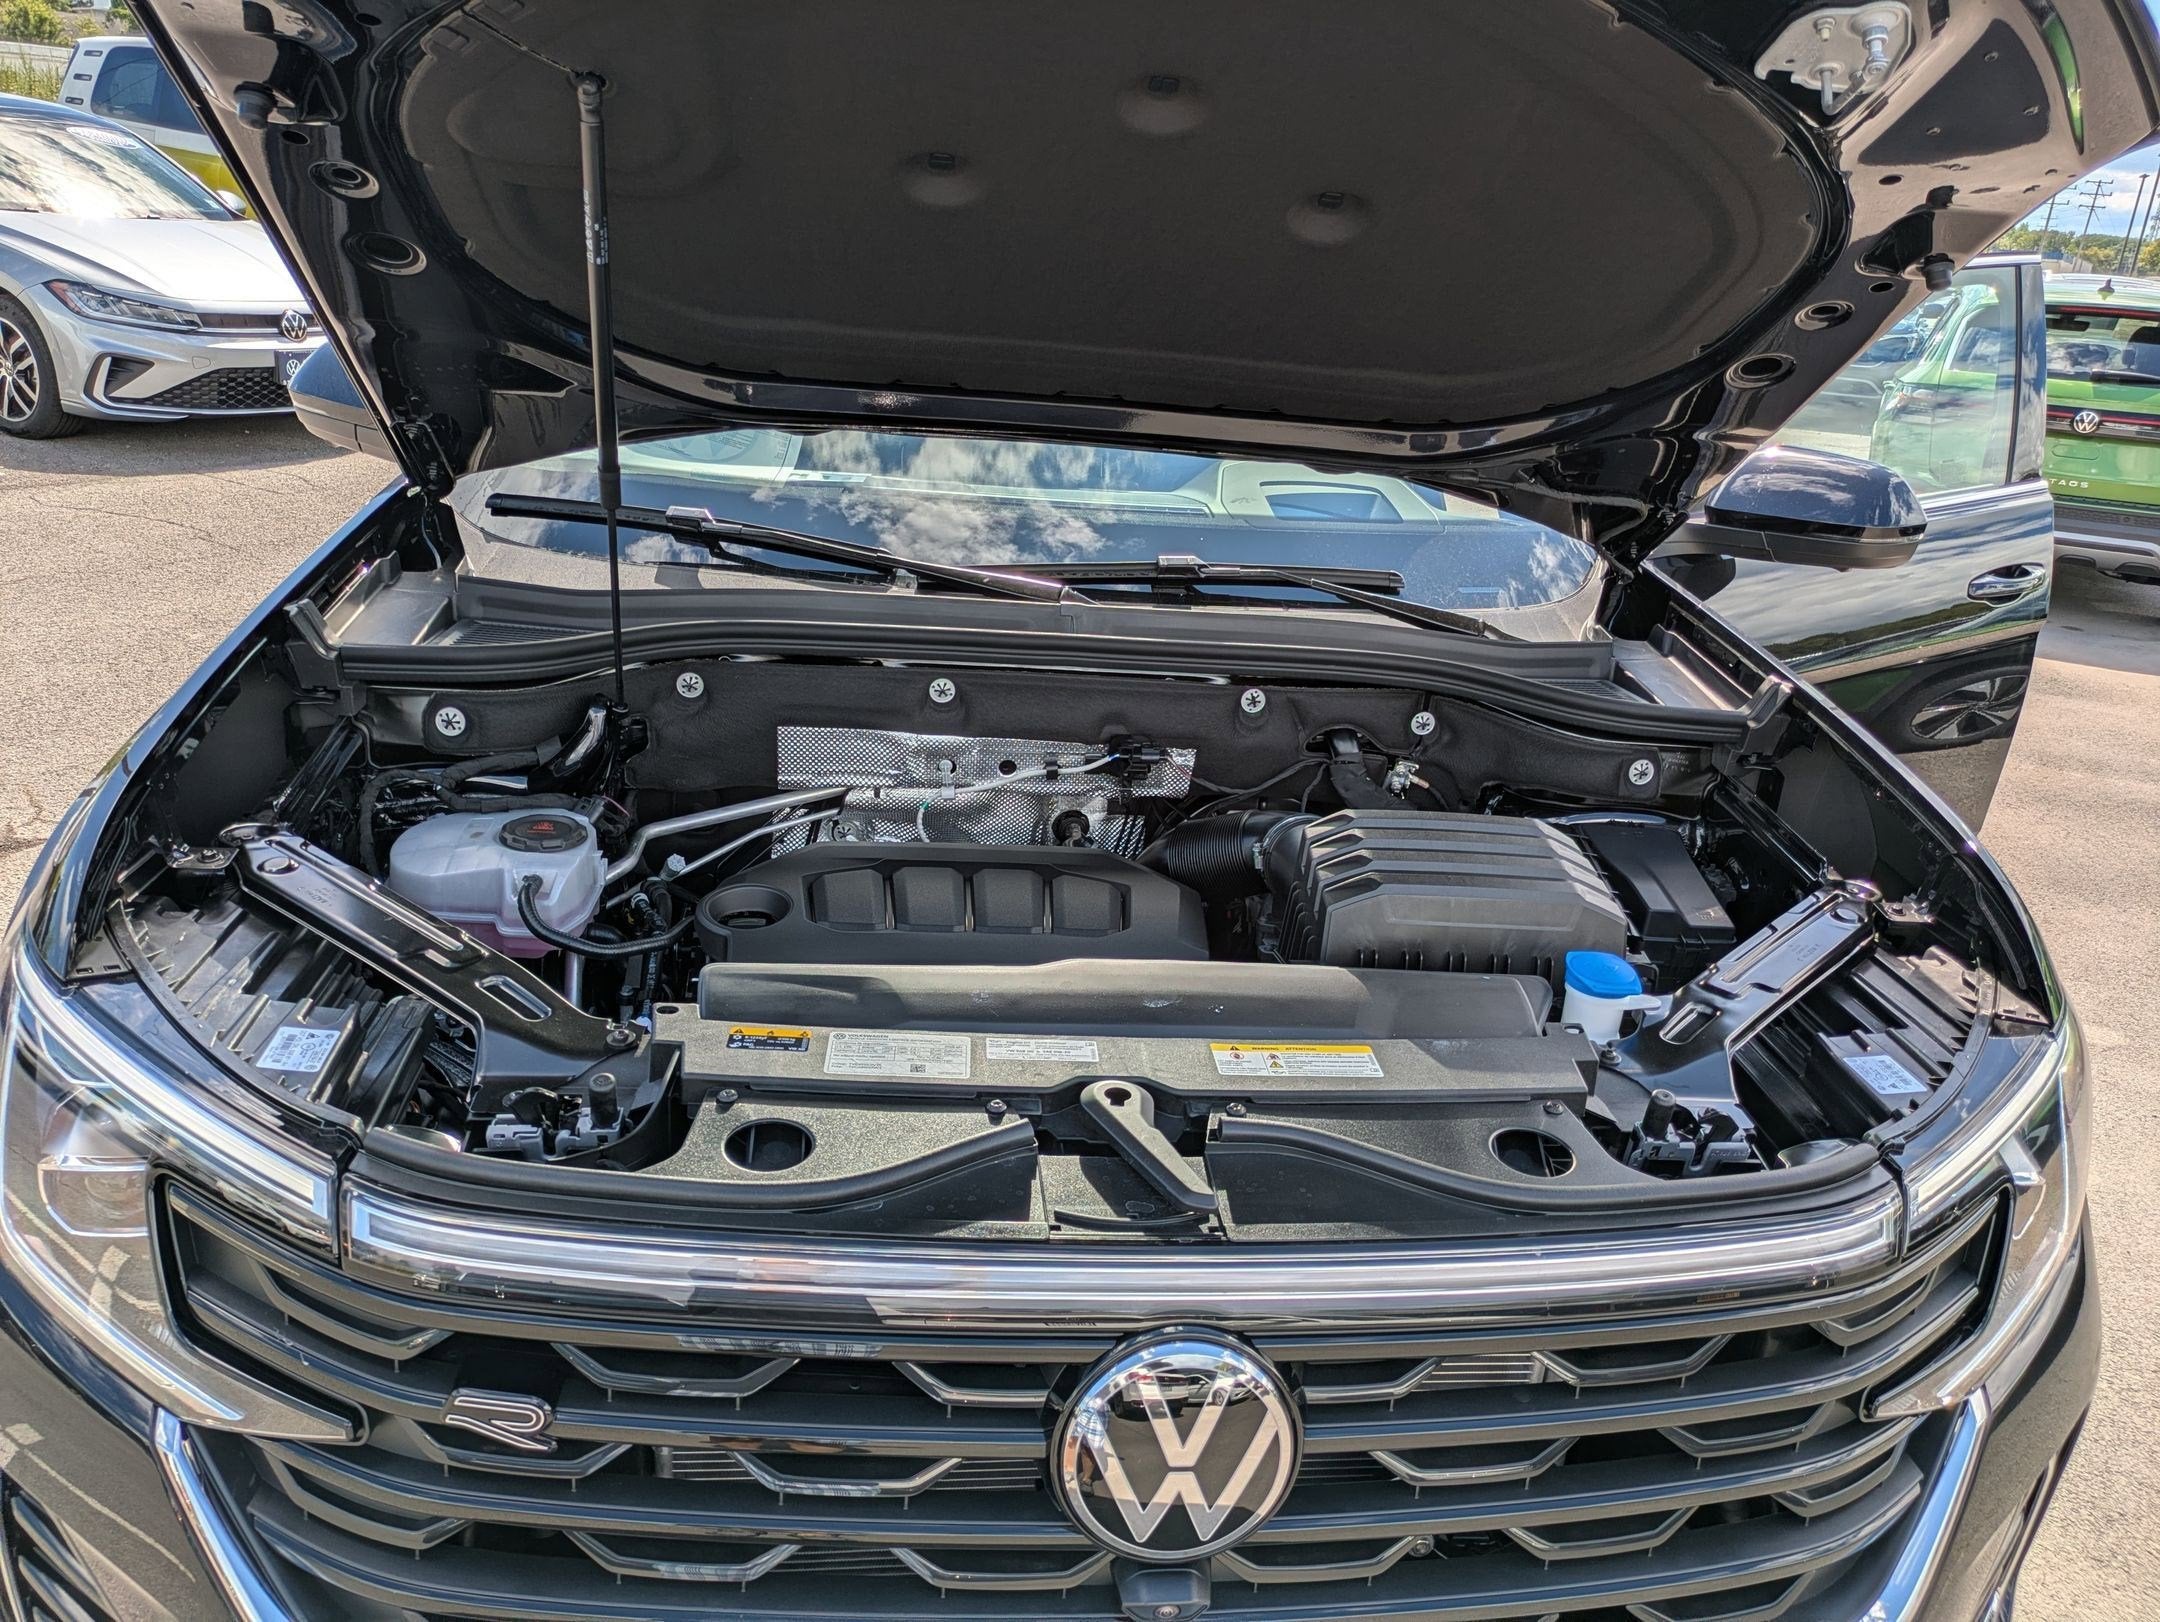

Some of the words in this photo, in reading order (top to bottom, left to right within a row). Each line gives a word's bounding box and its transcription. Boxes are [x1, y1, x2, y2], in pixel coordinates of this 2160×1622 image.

[2074, 411, 2099, 433] VW
[2049, 478, 2089, 488] TAOS
[445, 1396, 549, 1450] R
[1074, 1358, 1284, 1549] VW
